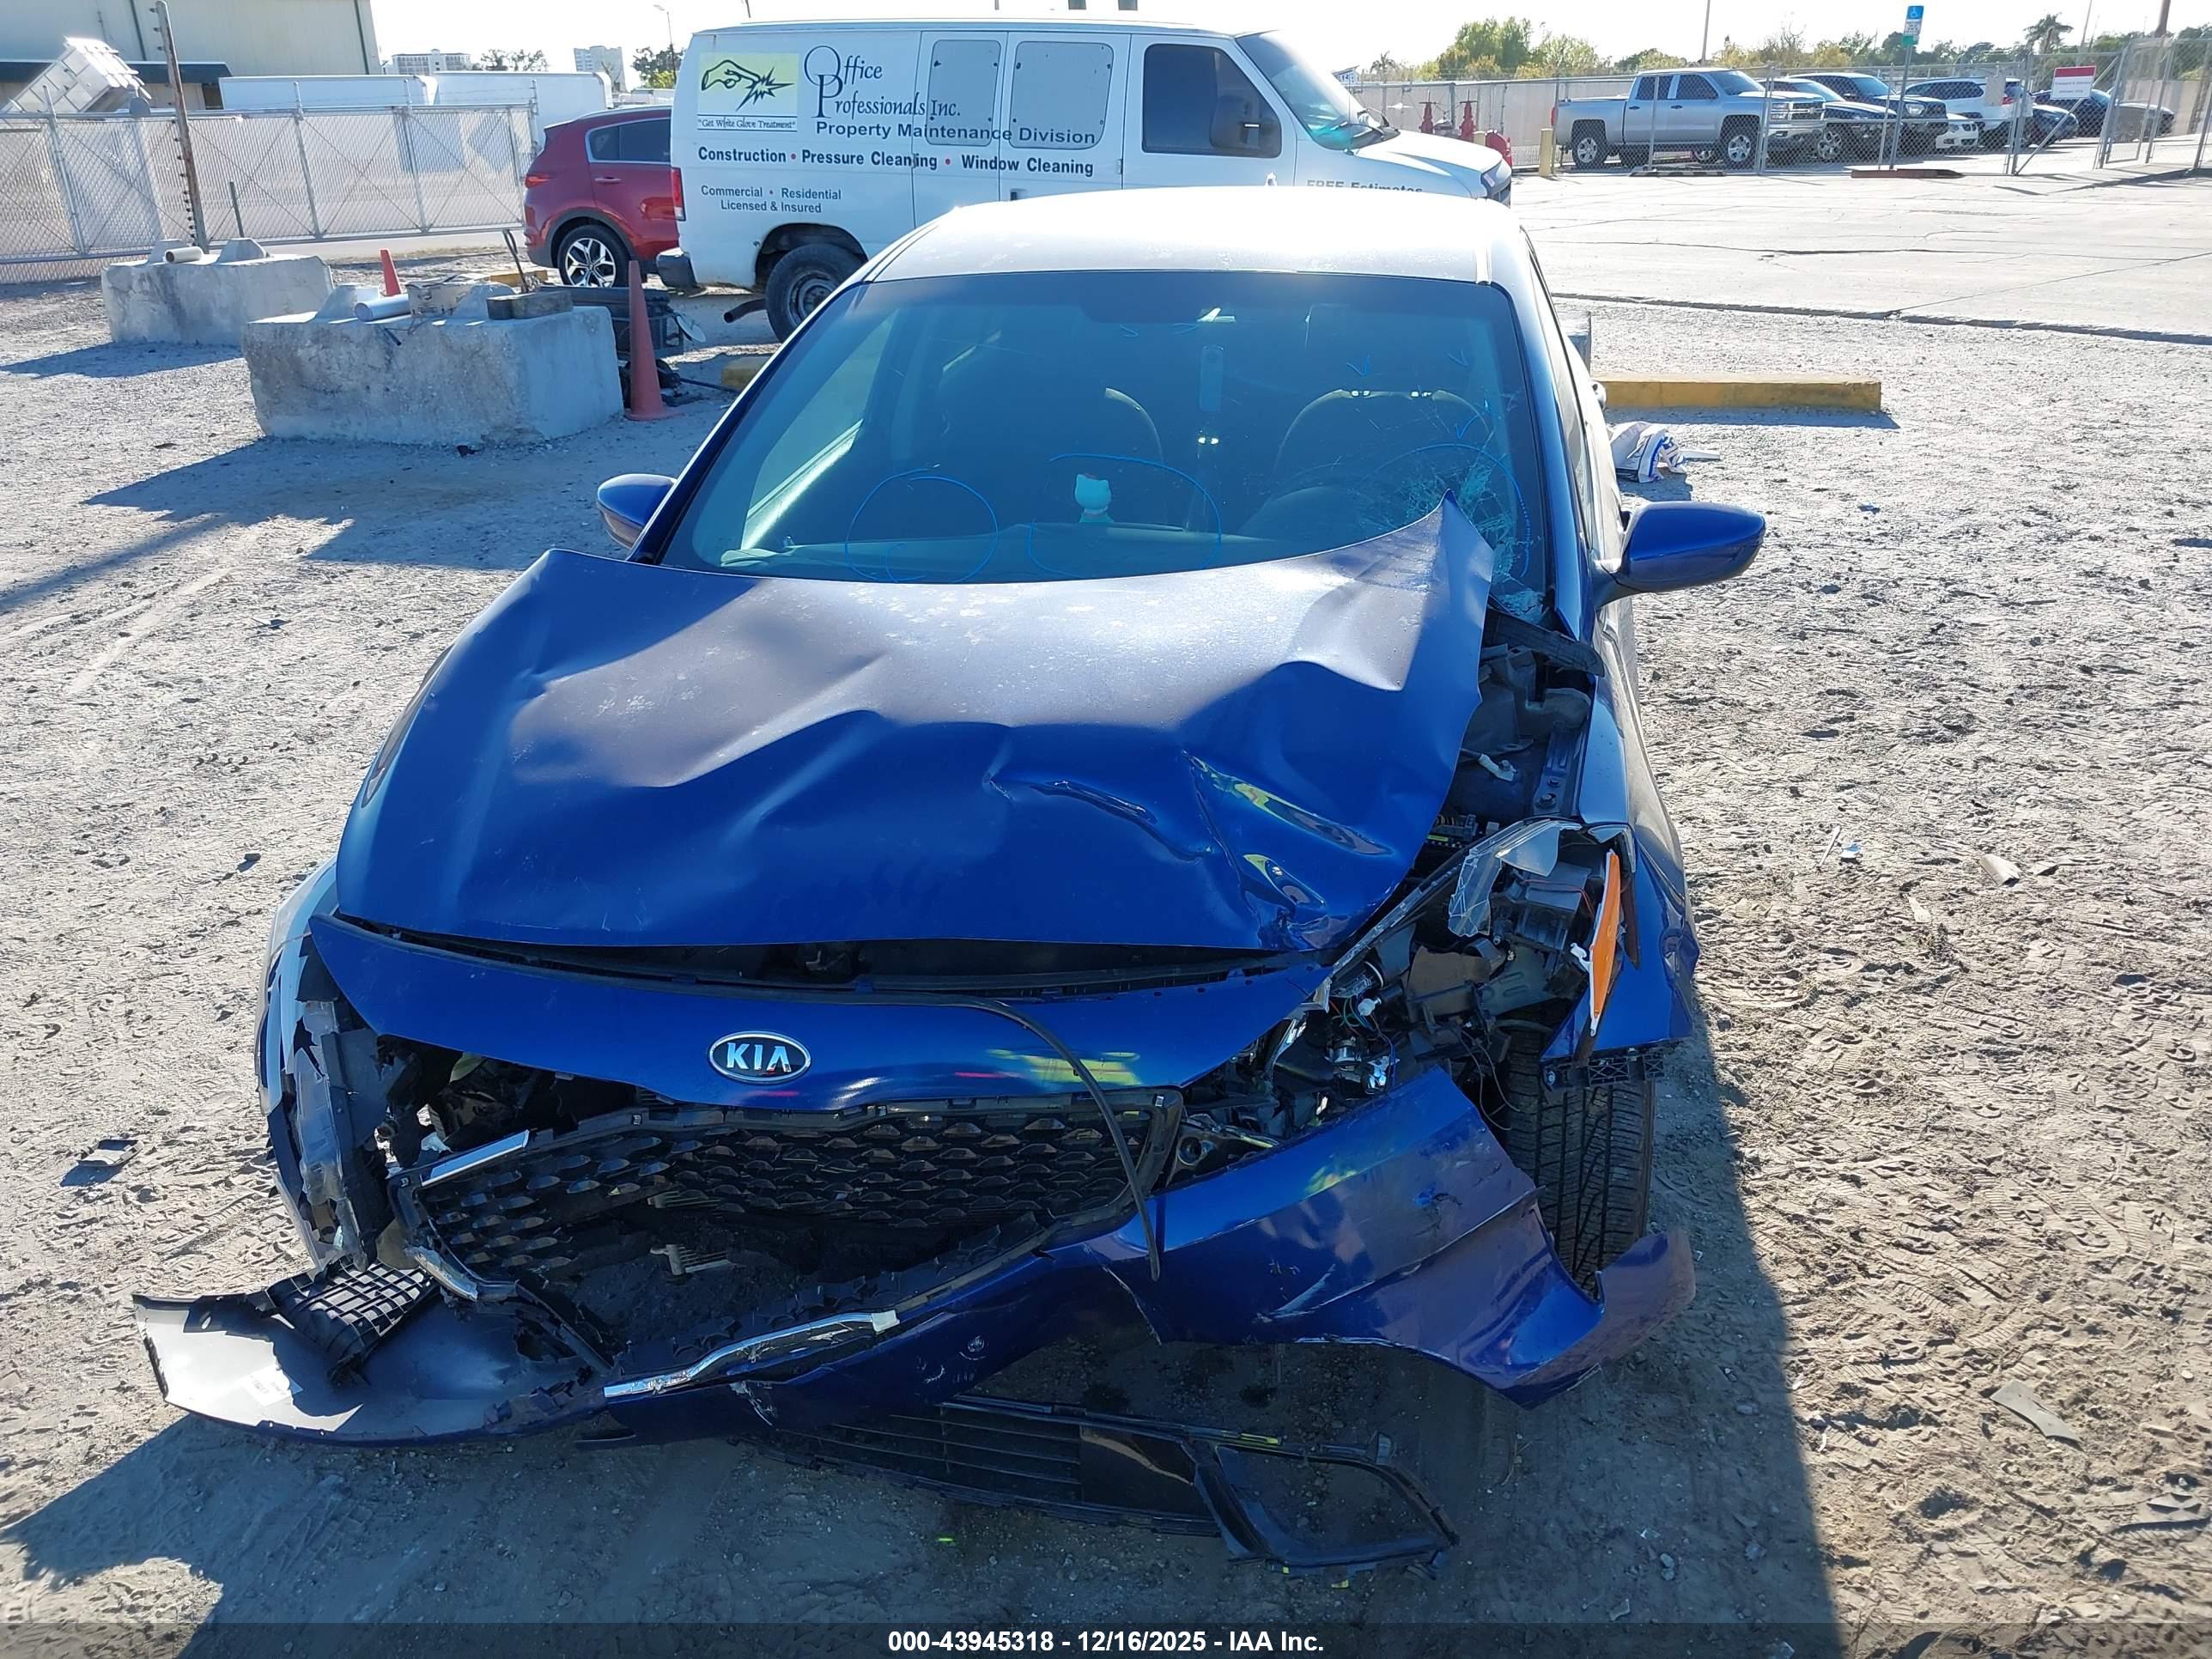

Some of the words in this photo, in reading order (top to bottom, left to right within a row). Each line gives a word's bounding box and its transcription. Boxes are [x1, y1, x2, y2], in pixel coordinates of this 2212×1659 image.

[805, 45, 883, 86] Office
[811, 74, 926, 120] Professionals
[930, 99, 961, 117] Inc.
[716, 117, 735, 129] White
[737, 117, 757, 129] Glove
[816, 121, 892, 139] Property
[897, 123, 1012, 142] Maintenance
[1019, 126, 1096, 144] Division
[698, 146, 787, 163] Construction
[801, 149, 865, 166] Pressure
[871, 151, 938, 171] Cleaning
[961, 154, 1019, 172] Window
[1027, 157, 1094, 177] Cleaning
[701, 185, 763, 198] Commercial
[781, 187, 842, 200] Residential
[720, 199, 768, 211] Licensed
[769, 201, 778, 212] &
[781, 202, 822, 214] Insured
[726, 1042, 792, 1073] KIA
